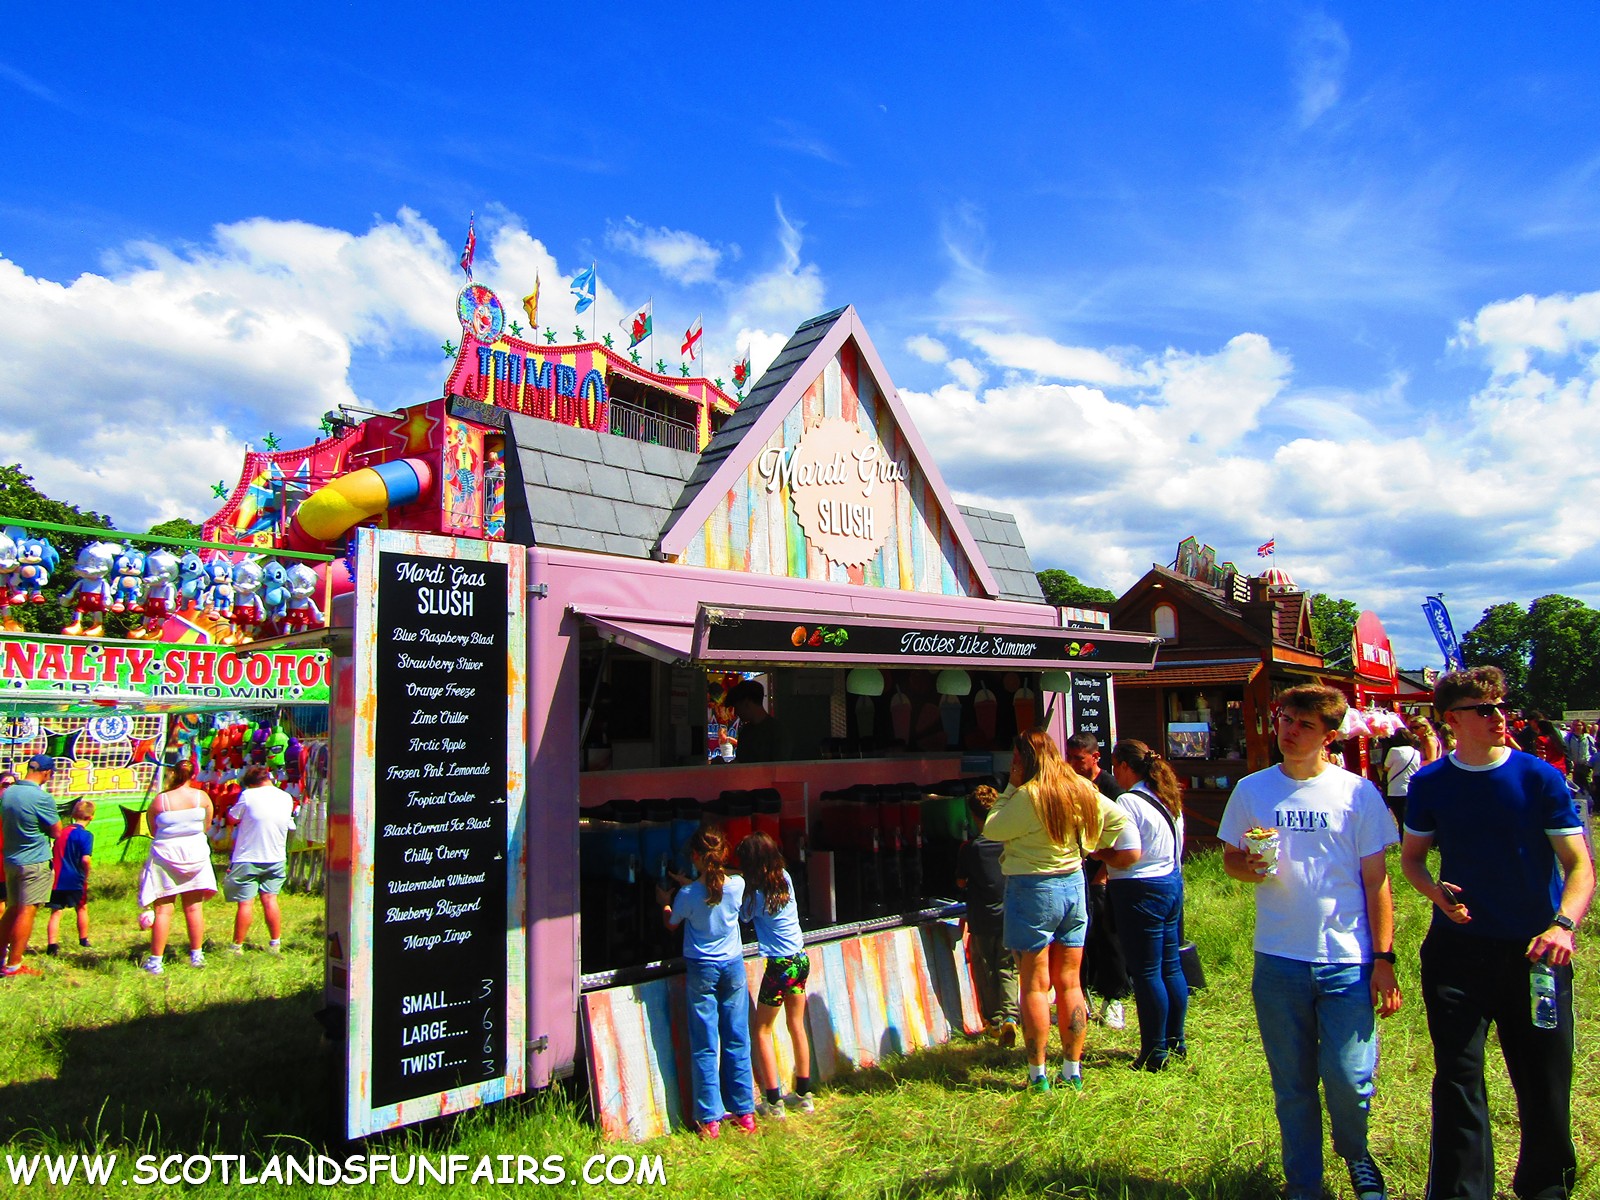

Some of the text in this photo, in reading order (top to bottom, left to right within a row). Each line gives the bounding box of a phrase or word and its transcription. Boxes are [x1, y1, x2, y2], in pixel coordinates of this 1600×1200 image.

[463, 346, 607, 431] JUMBO
[758, 444, 909, 497] Mardi Gras
[818, 499, 874, 540] SLUSH
[396, 562, 486, 590] Mardi Gras
[418, 586, 473, 616] SLUSH
[392, 628, 494, 646] Blue Raspberry Blast
[900, 632, 1037, 656] Tastes Like Summer
[0, 642, 153, 683] NALTY
[398, 653, 483, 673] Strawberry Shiver
[153, 686, 178, 696] IN
[188, 686, 221, 697] TO
[230, 687, 283, 698] WIN!
[406, 683, 475, 699] Orange Freeze
[411, 710, 468, 724] Lime Chiller
[409, 738, 466, 753] Arctic Apple
[386, 762, 490, 780] Frozen Pink Lemonade
[407, 791, 475, 808] Tropical Cooler
[383, 817, 491, 837] Black Currant Ice Blast
[404, 845, 469, 864] Chilly Cherry
[388, 872, 485, 894] Watermelon Whiteout
[385, 897, 481, 923] Blueberry Blizzard
[403, 929, 472, 950] Mango Zingo
[479, 979, 493, 998] 3
[483, 1008, 492, 1029] 6
[484, 1034, 491, 1053] 6
[483, 1060, 494, 1074] 3
